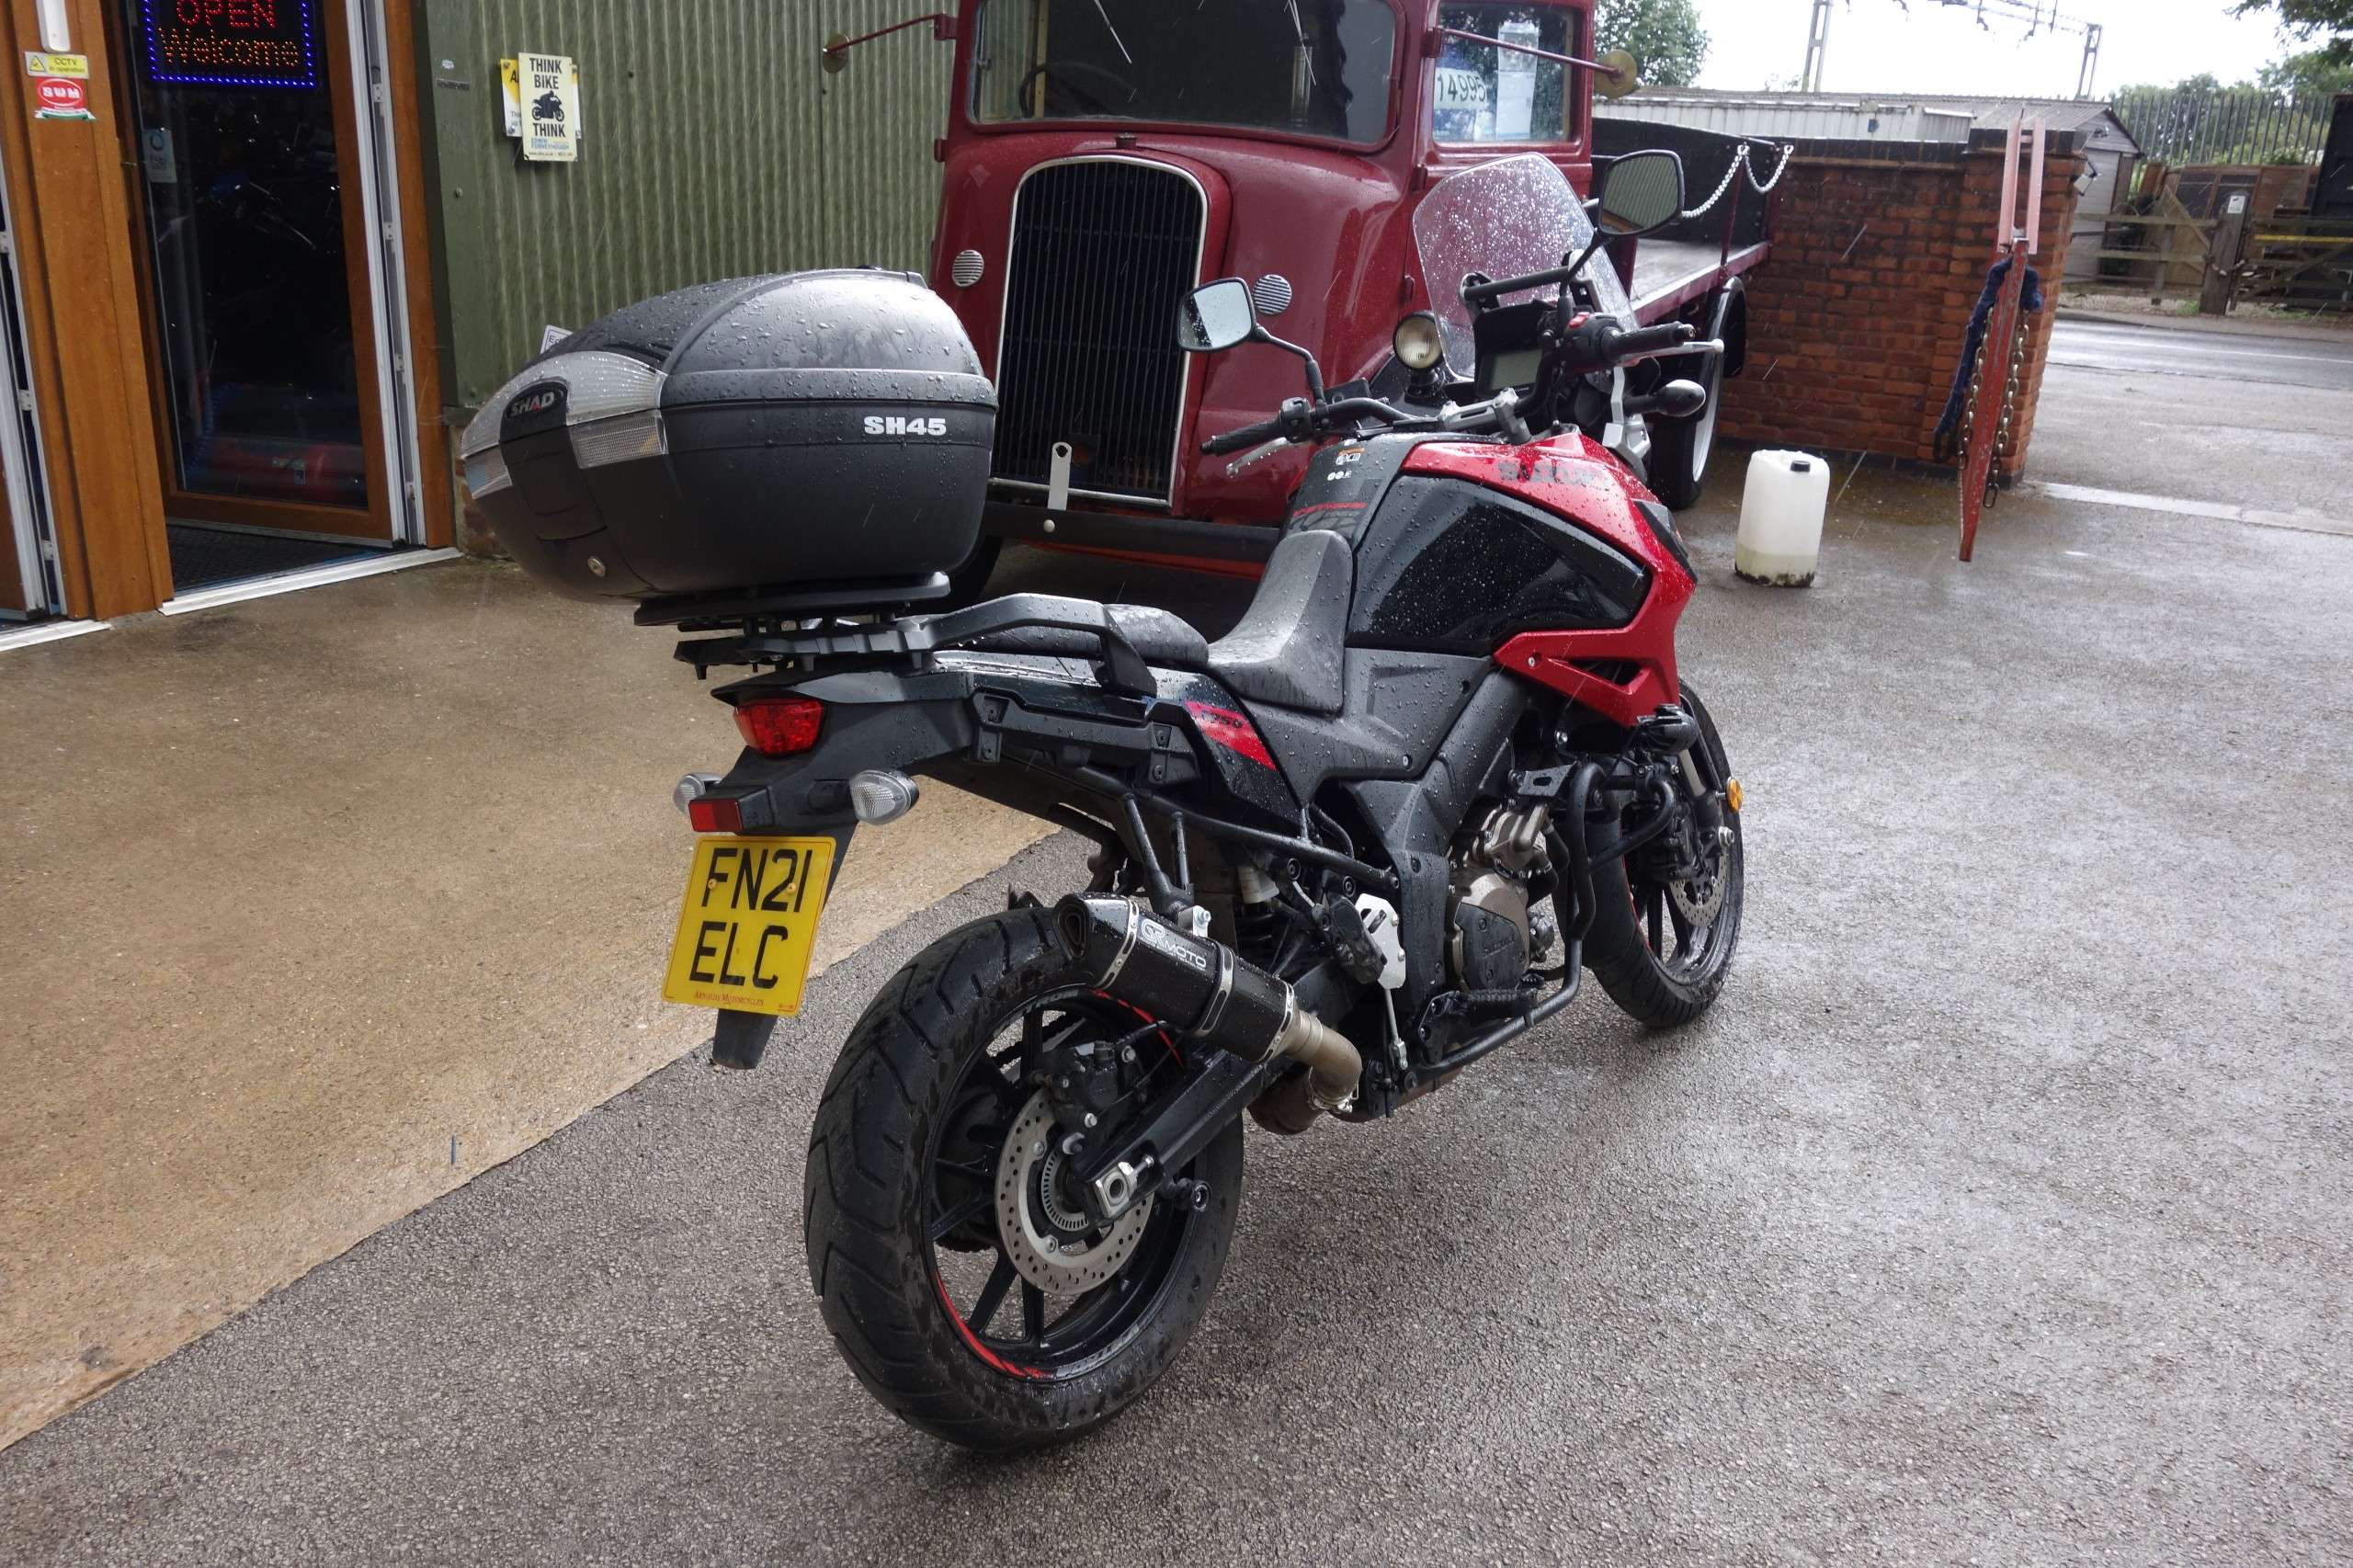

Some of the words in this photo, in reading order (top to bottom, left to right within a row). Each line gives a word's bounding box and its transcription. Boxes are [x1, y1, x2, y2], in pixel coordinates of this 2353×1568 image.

[176, 0, 276, 28] OPEN
[157, 28, 300, 67] Welcome
[529, 58, 563, 74] THINK
[42, 86, 80, 99] SWM
[534, 74, 560, 89] BIKE
[1438, 74, 1486, 102] 14995
[533, 123, 566, 138] THINK
[510, 392, 555, 416] SHAD
[864, 415, 947, 437] SH45
[701, 847, 813, 913] FN21
[689, 920, 789, 989] ELC
[1165, 939, 1207, 968] MOTO
